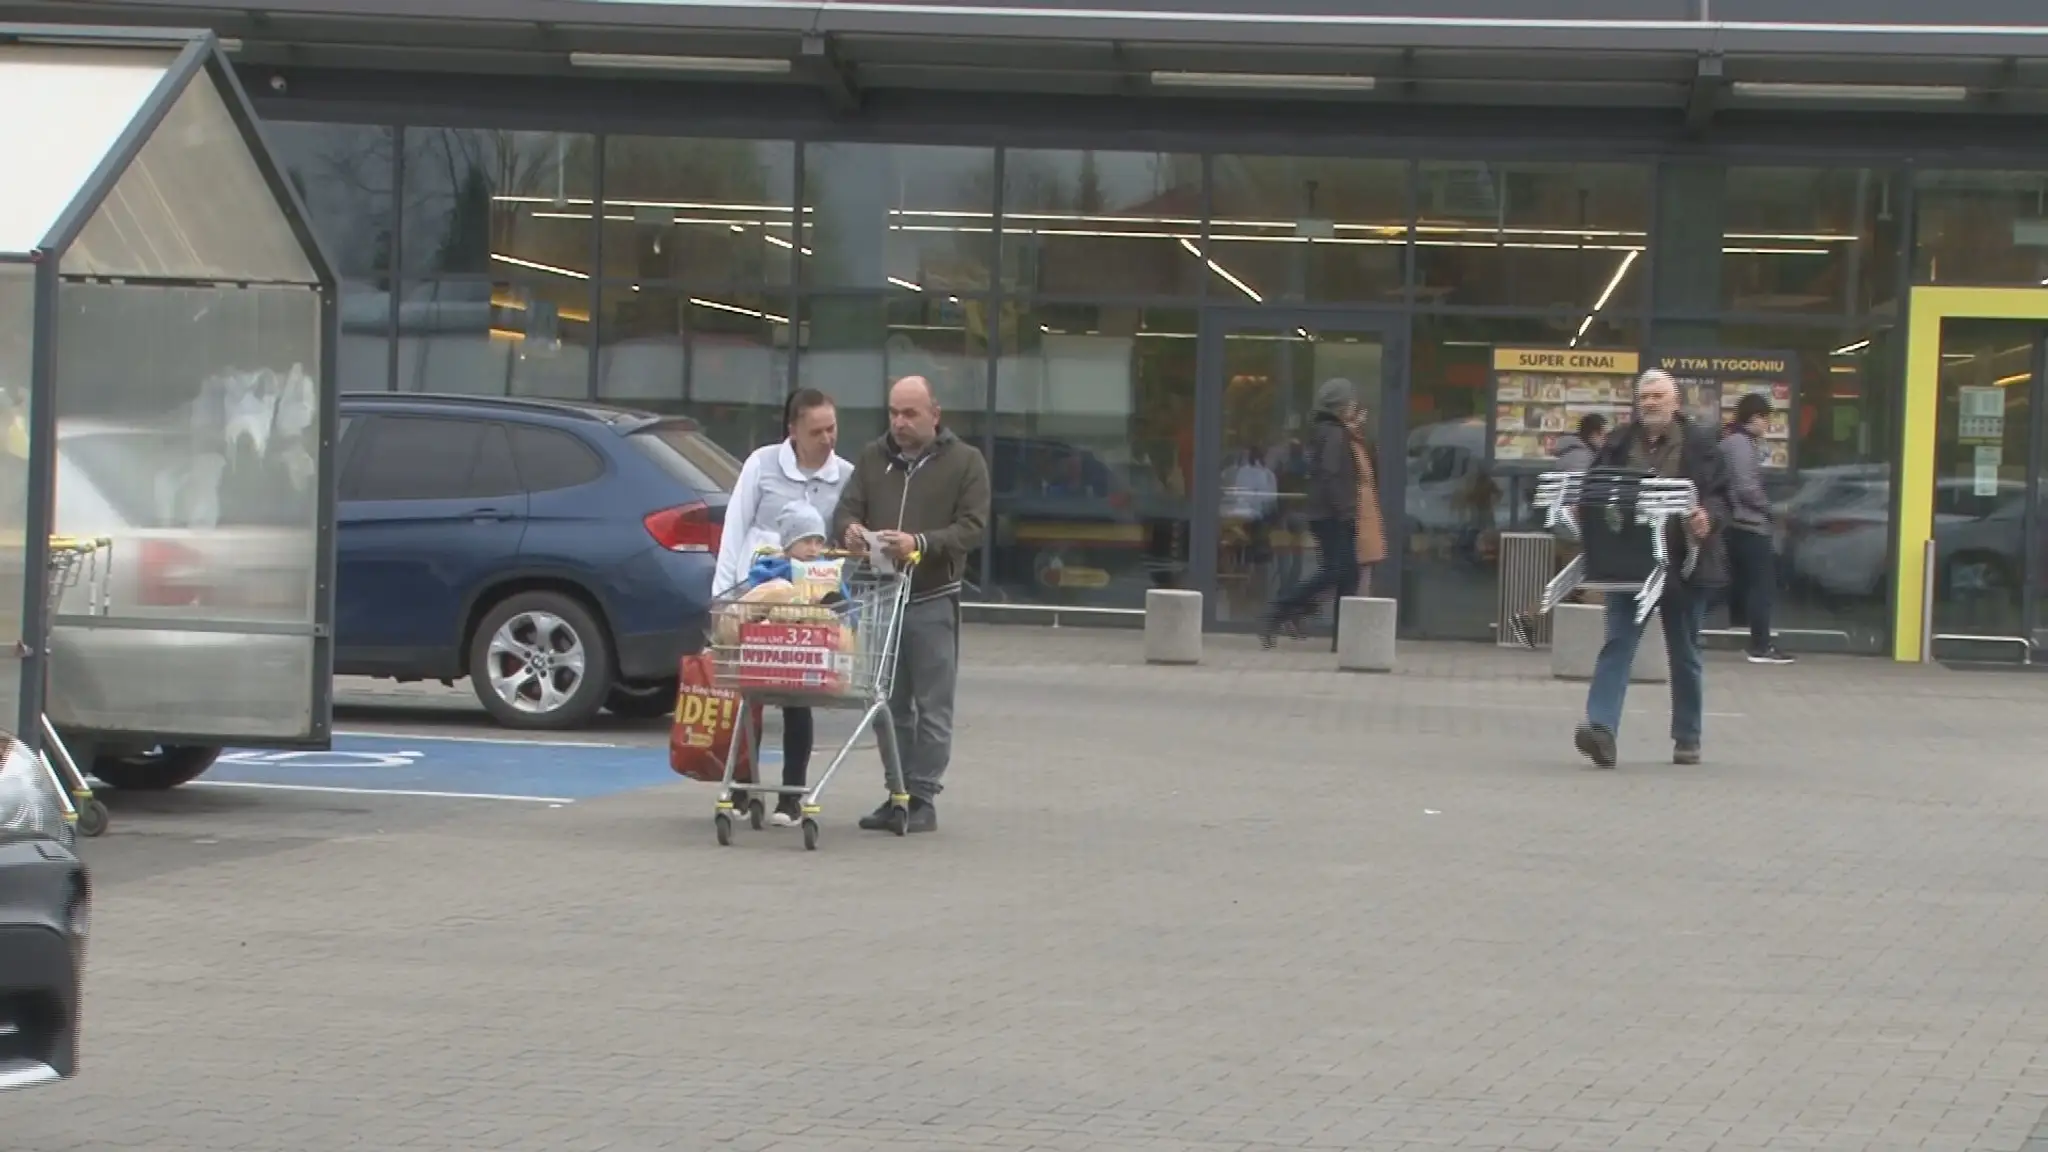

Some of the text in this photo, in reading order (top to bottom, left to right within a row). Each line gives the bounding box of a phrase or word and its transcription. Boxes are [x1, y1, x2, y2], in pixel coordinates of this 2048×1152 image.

[1518, 353, 1615, 369] SUPER CENA!
[1661, 358, 1785, 373] W TYM TYGODNIU
[675, 694, 734, 736] IDĘ!
